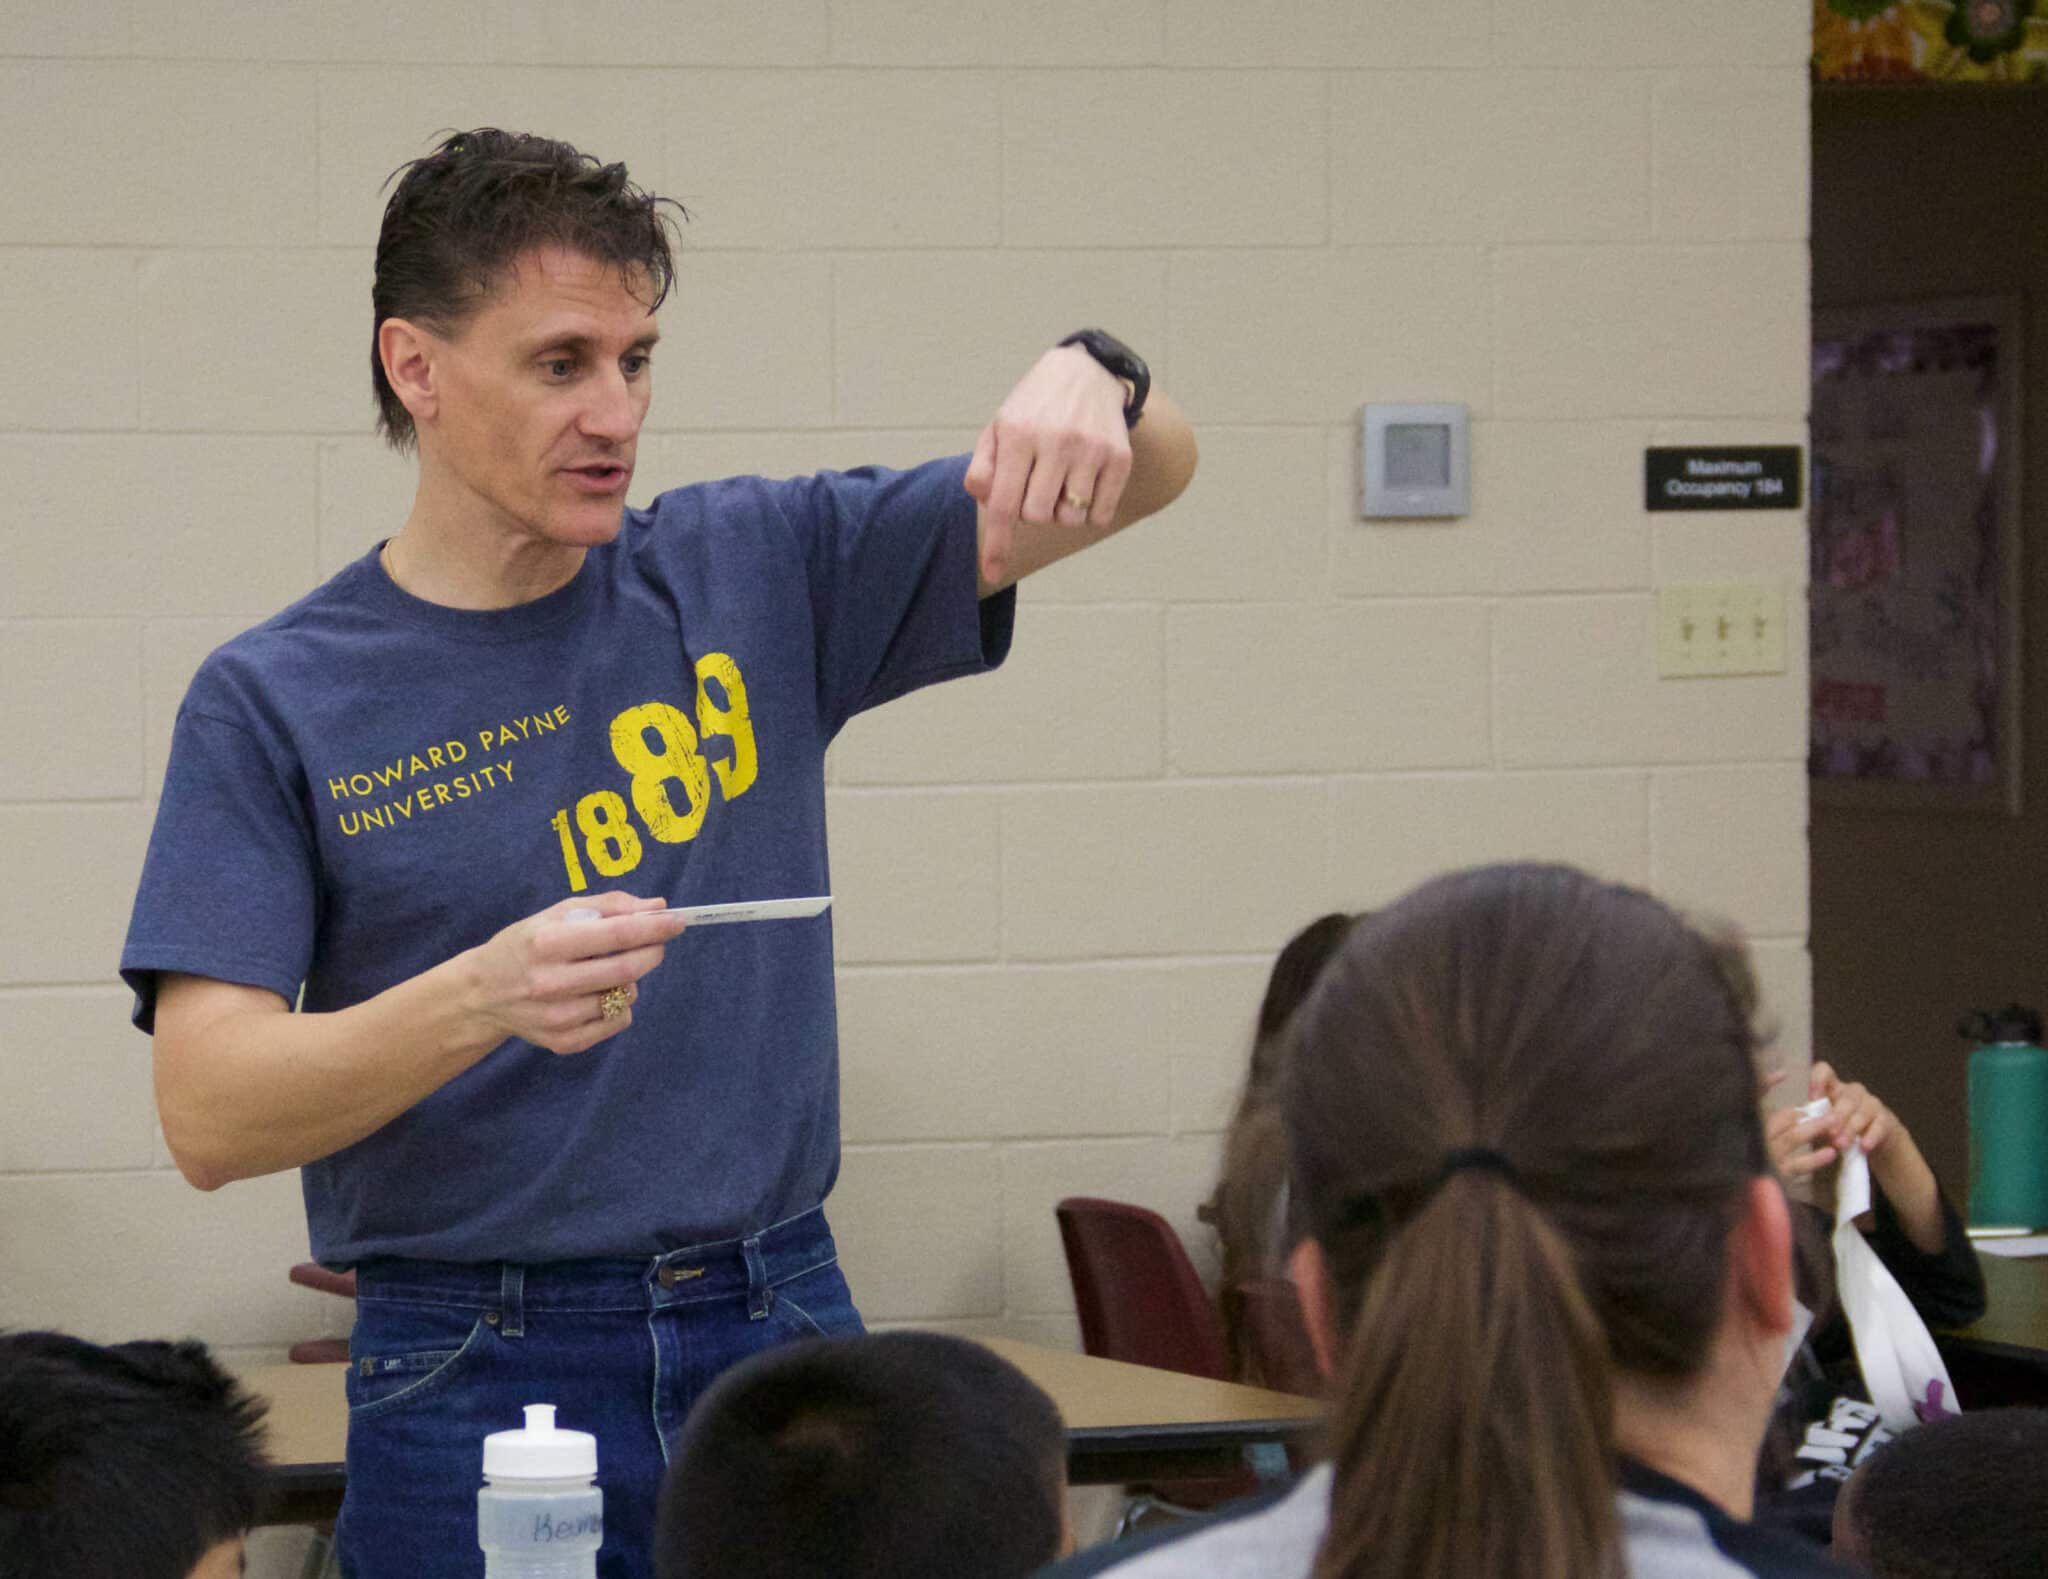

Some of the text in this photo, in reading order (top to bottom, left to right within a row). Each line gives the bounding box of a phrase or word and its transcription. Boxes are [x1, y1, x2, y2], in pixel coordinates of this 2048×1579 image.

[328, 704, 571, 801] HOWARD PAYNE
[338, 760, 514, 836] UNIVERSITY
[551, 651, 759, 892] 1889
